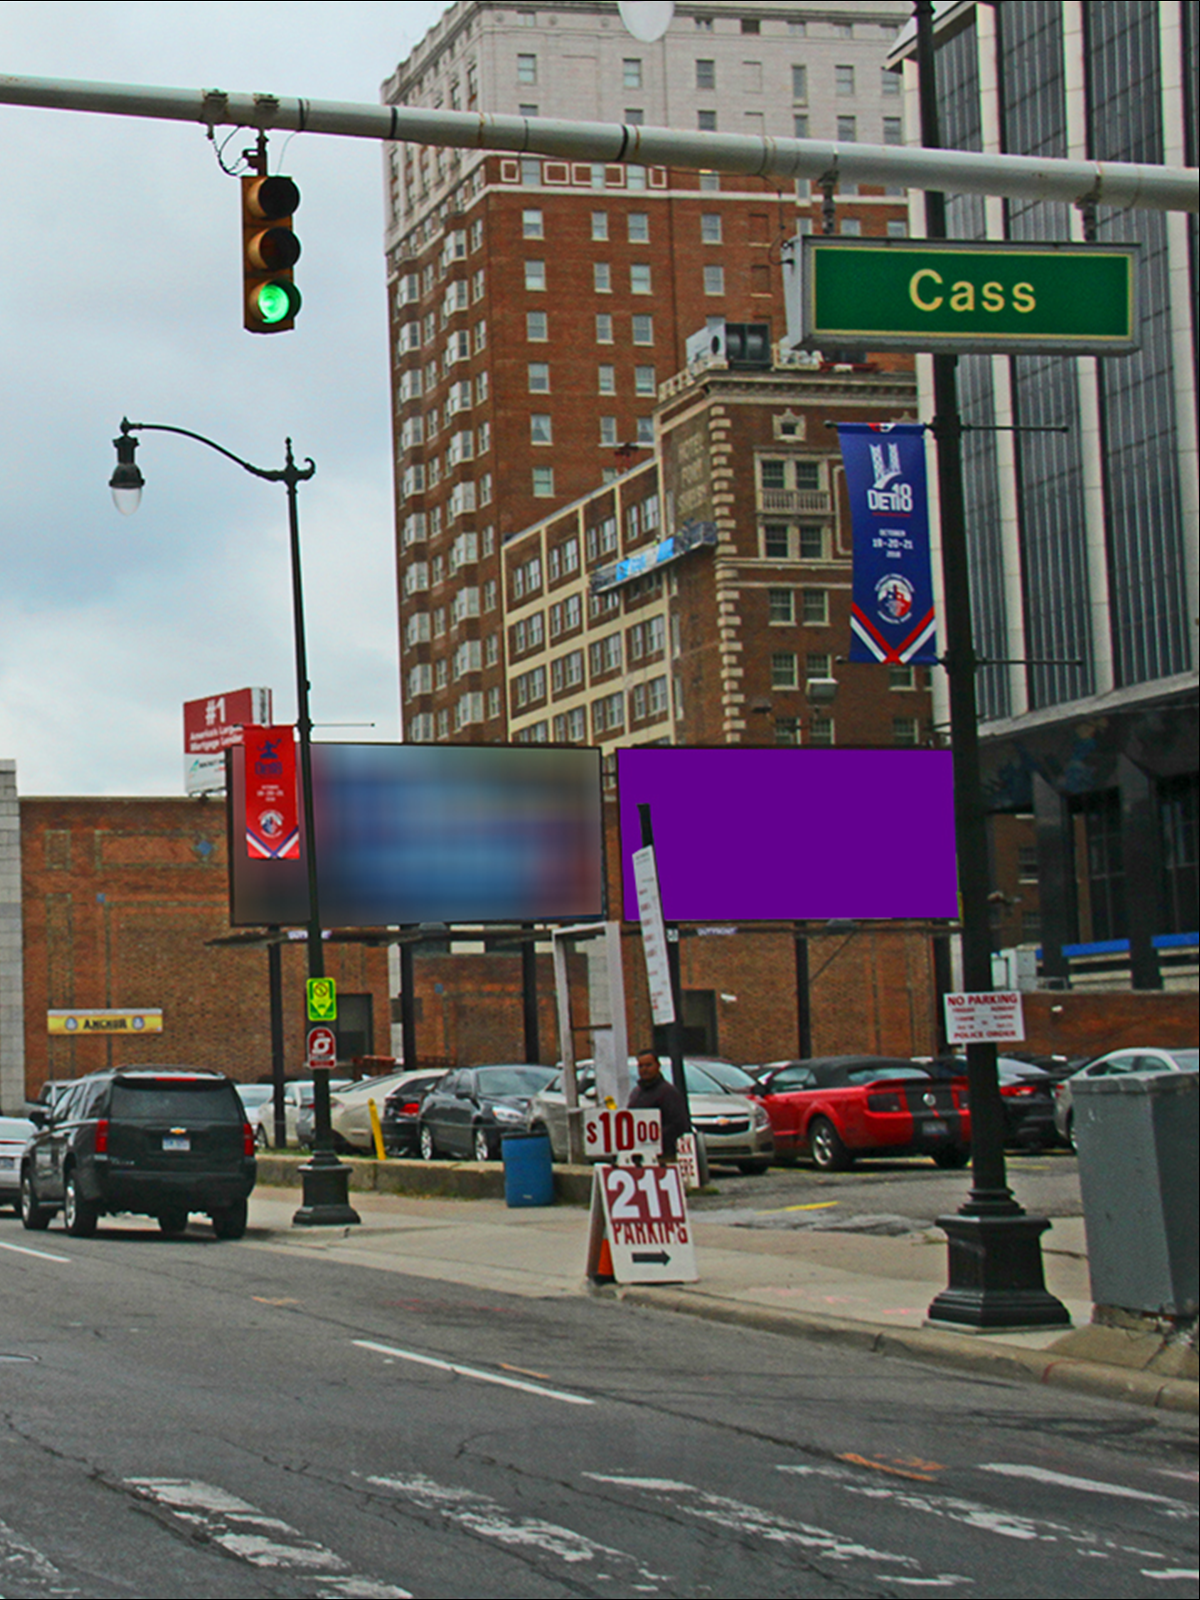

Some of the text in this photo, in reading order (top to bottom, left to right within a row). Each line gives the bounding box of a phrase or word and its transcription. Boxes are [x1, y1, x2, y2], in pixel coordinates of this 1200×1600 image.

[908, 268, 1037, 313] Cass
[205, 697, 226, 726] #1
[947, 992, 1018, 1006] NO PARKING
[607, 1169, 682, 1219] 211
